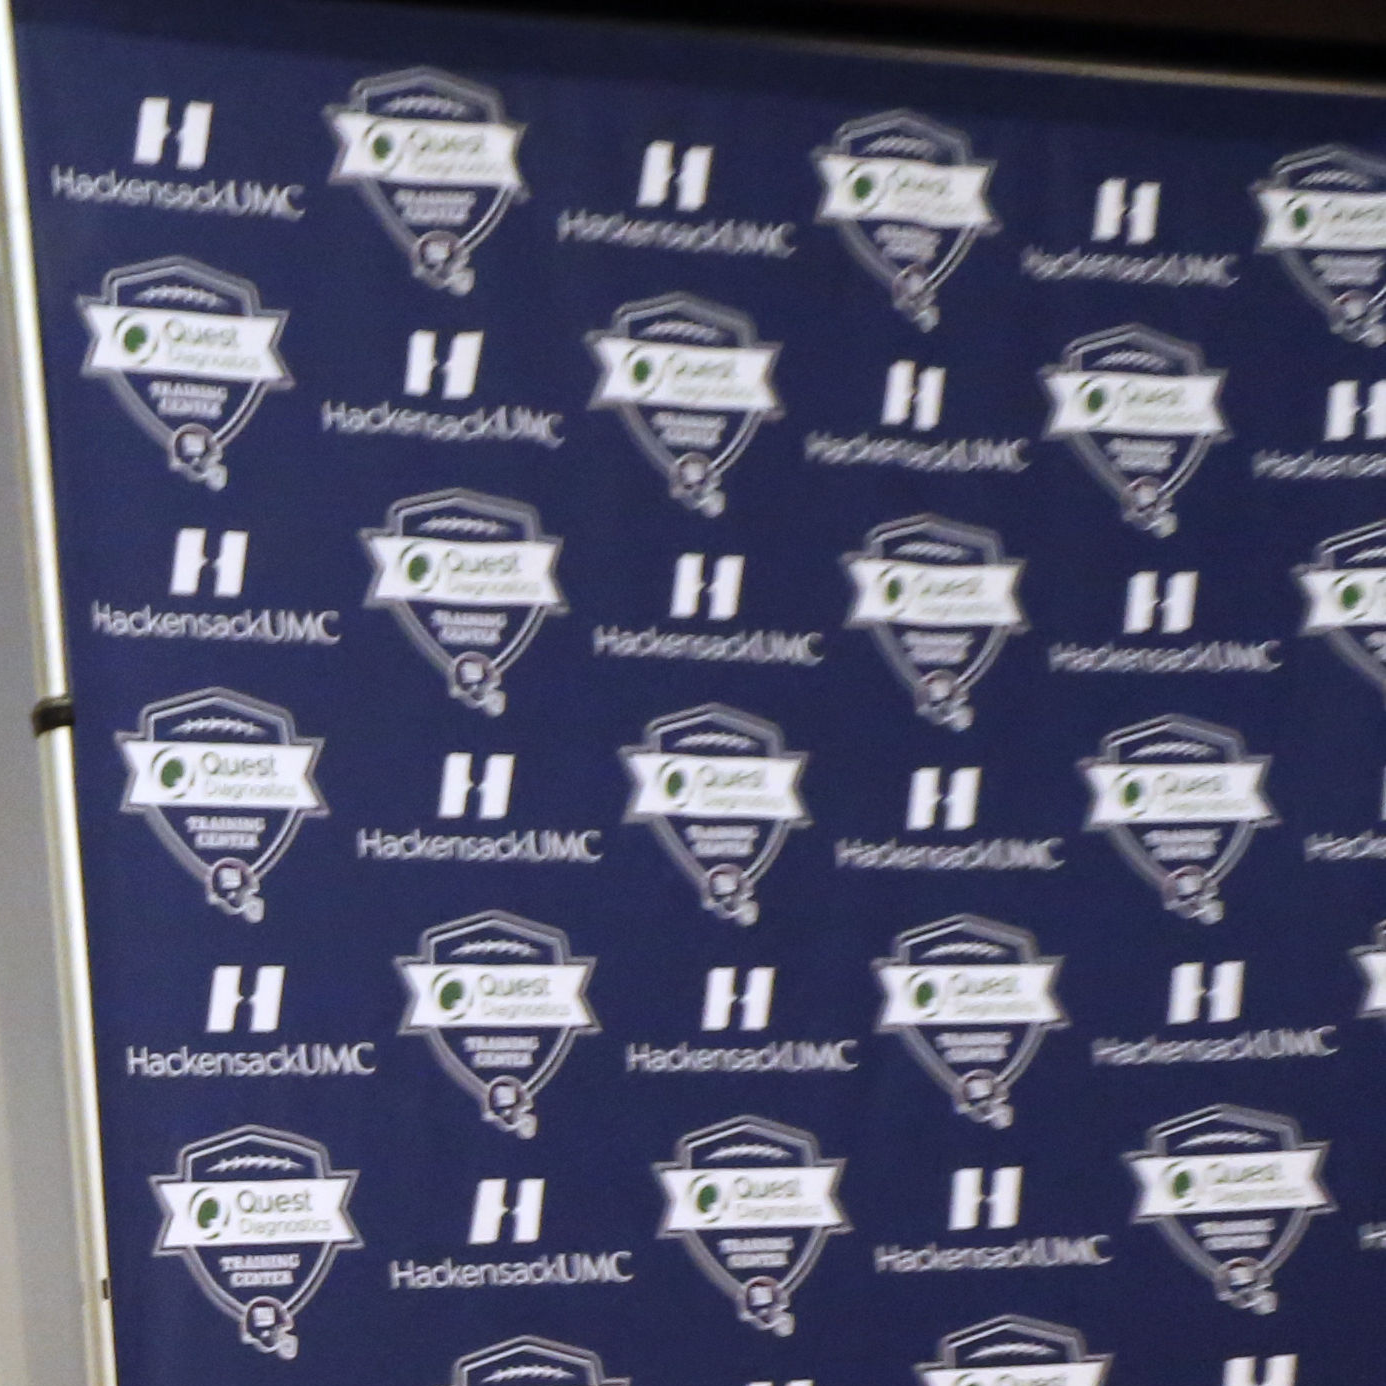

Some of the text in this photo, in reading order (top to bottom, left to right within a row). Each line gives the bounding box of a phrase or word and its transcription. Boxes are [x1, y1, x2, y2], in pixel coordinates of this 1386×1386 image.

[51, 165, 304, 219] HackensackUMC
[164, 319, 240, 348] Quest
[446, 549, 519, 575] Quest
[92, 601, 340, 644] HackensackUMC
[201, 752, 277, 777] Quest
[356, 828, 602, 863] HackensackUMC
[479, 973, 551, 996] Quest
[126, 1042, 376, 1077] HackensackUMC
[733, 1175, 803, 1199] Quest
[237, 1188, 312, 1213] Quest
[239, 1216, 331, 1236] Diagnostics
[219, 1253, 300, 1272] TRAINING
[389, 1251, 633, 1289] HackensackUMC
